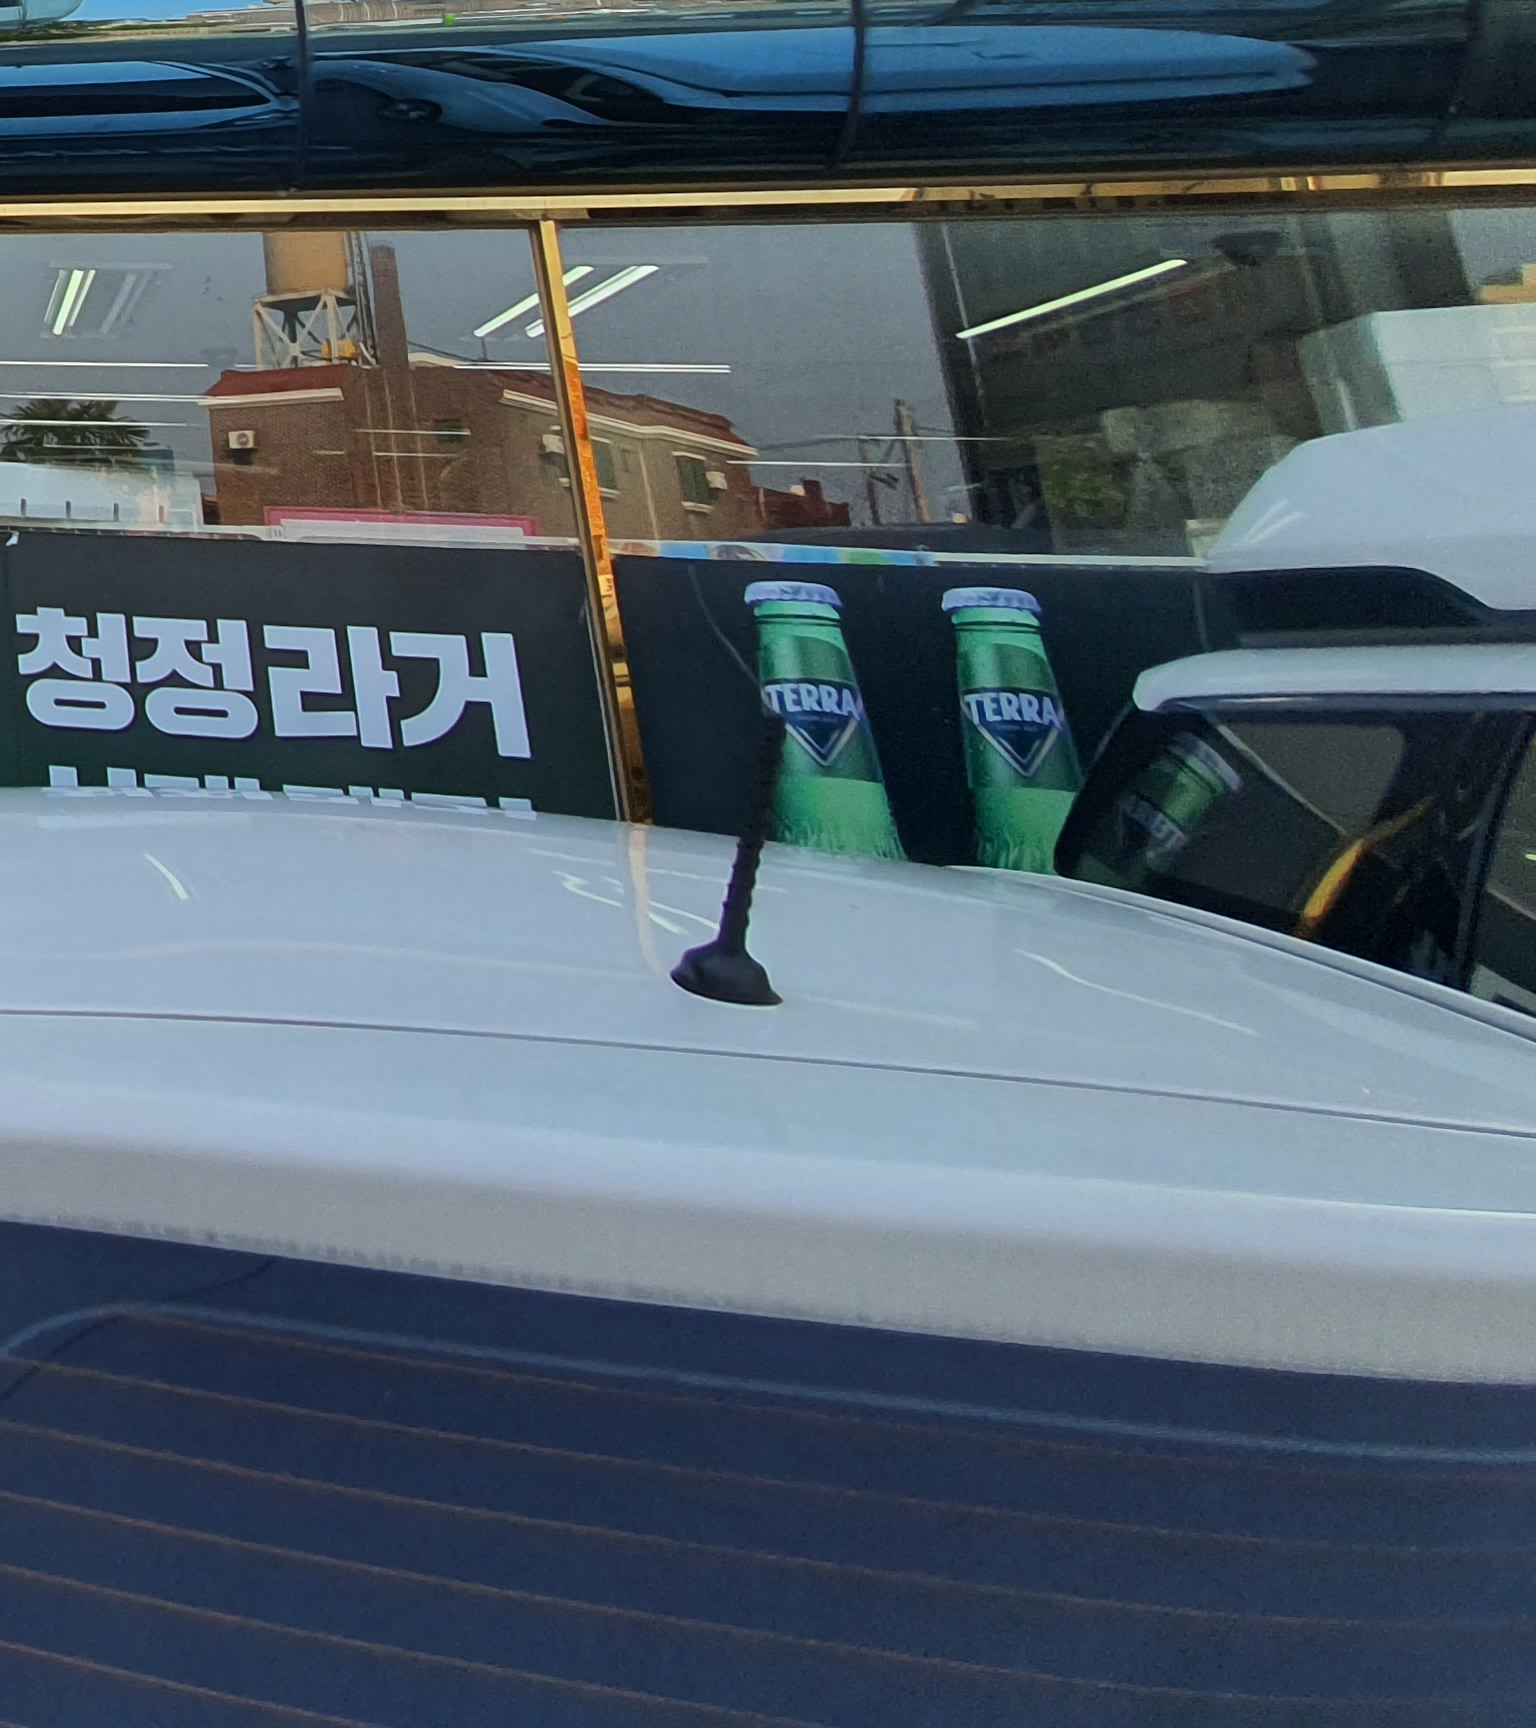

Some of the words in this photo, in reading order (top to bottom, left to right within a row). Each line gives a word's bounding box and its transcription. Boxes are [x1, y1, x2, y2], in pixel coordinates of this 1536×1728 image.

[14, 605, 532, 759] 청정라거
[764, 682, 861, 722] TERRA
[963, 691, 1063, 731] TERRA
